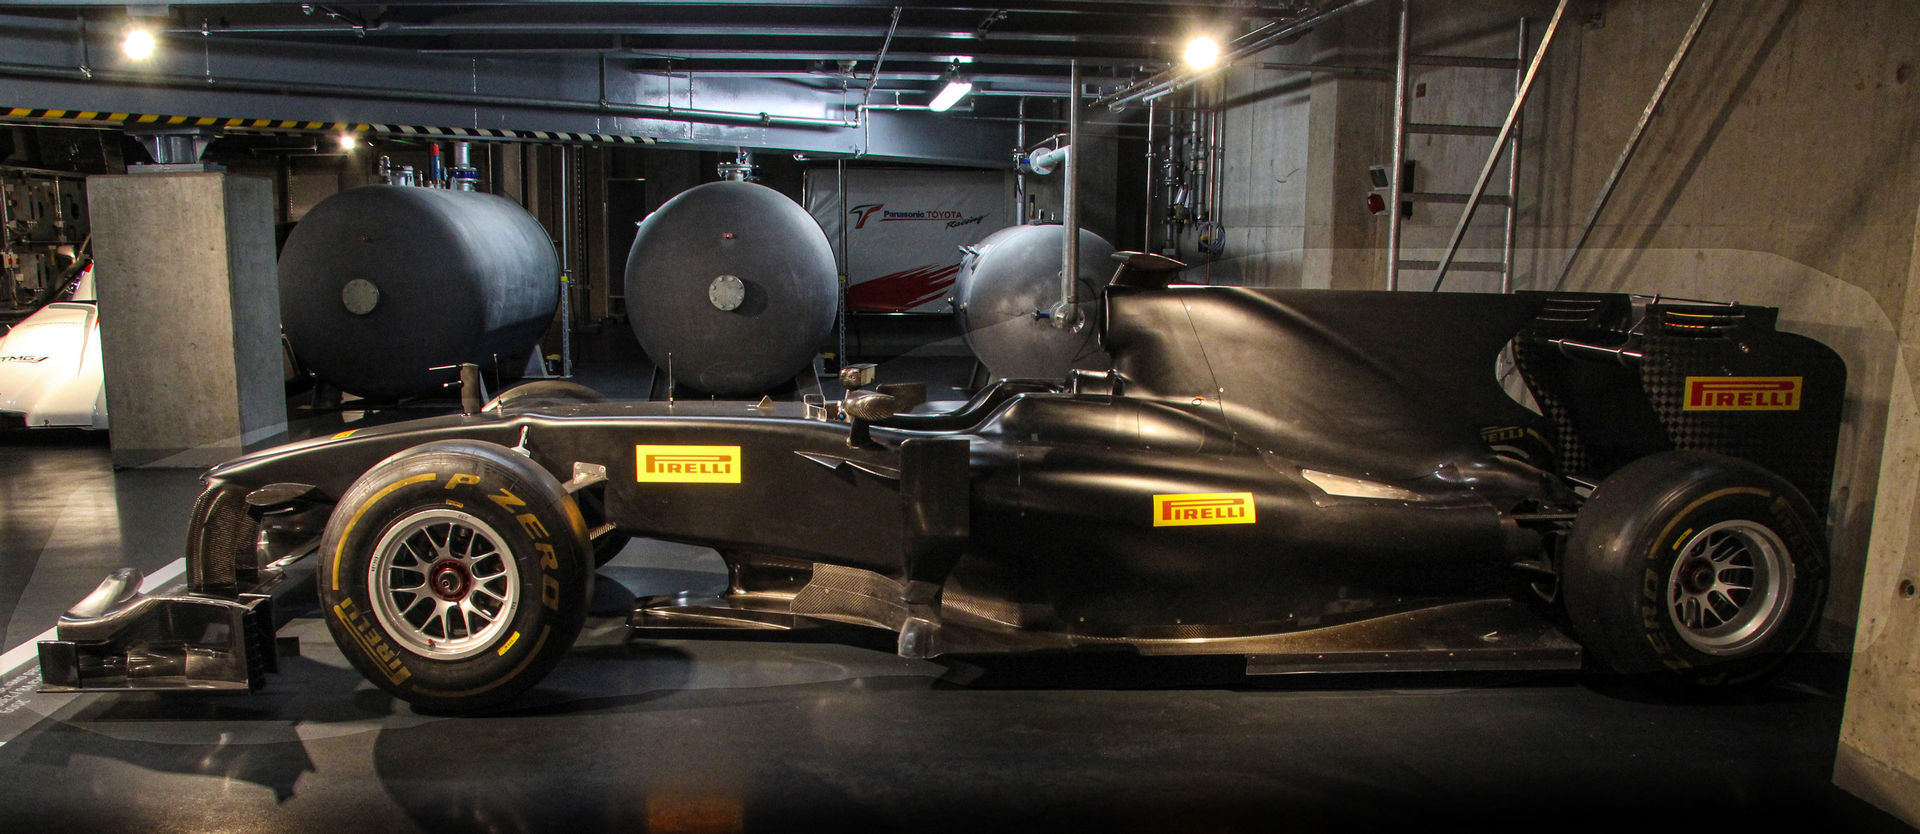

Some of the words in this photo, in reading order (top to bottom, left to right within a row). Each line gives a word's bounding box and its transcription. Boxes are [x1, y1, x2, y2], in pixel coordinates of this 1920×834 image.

[883, 210, 925, 219] Panasonic
[926, 210, 963, 219] TOYOTA
[944, 212, 991, 230] Racing
[1690, 381, 1795, 407] PIRELLI
[646, 455, 732, 474] PIRELLI
[1162, 498, 1245, 521] PIRELLI
[444, 473, 481, 489] P
[487, 488, 560, 611] ZERO
[333, 597, 412, 687] PIRELLI
